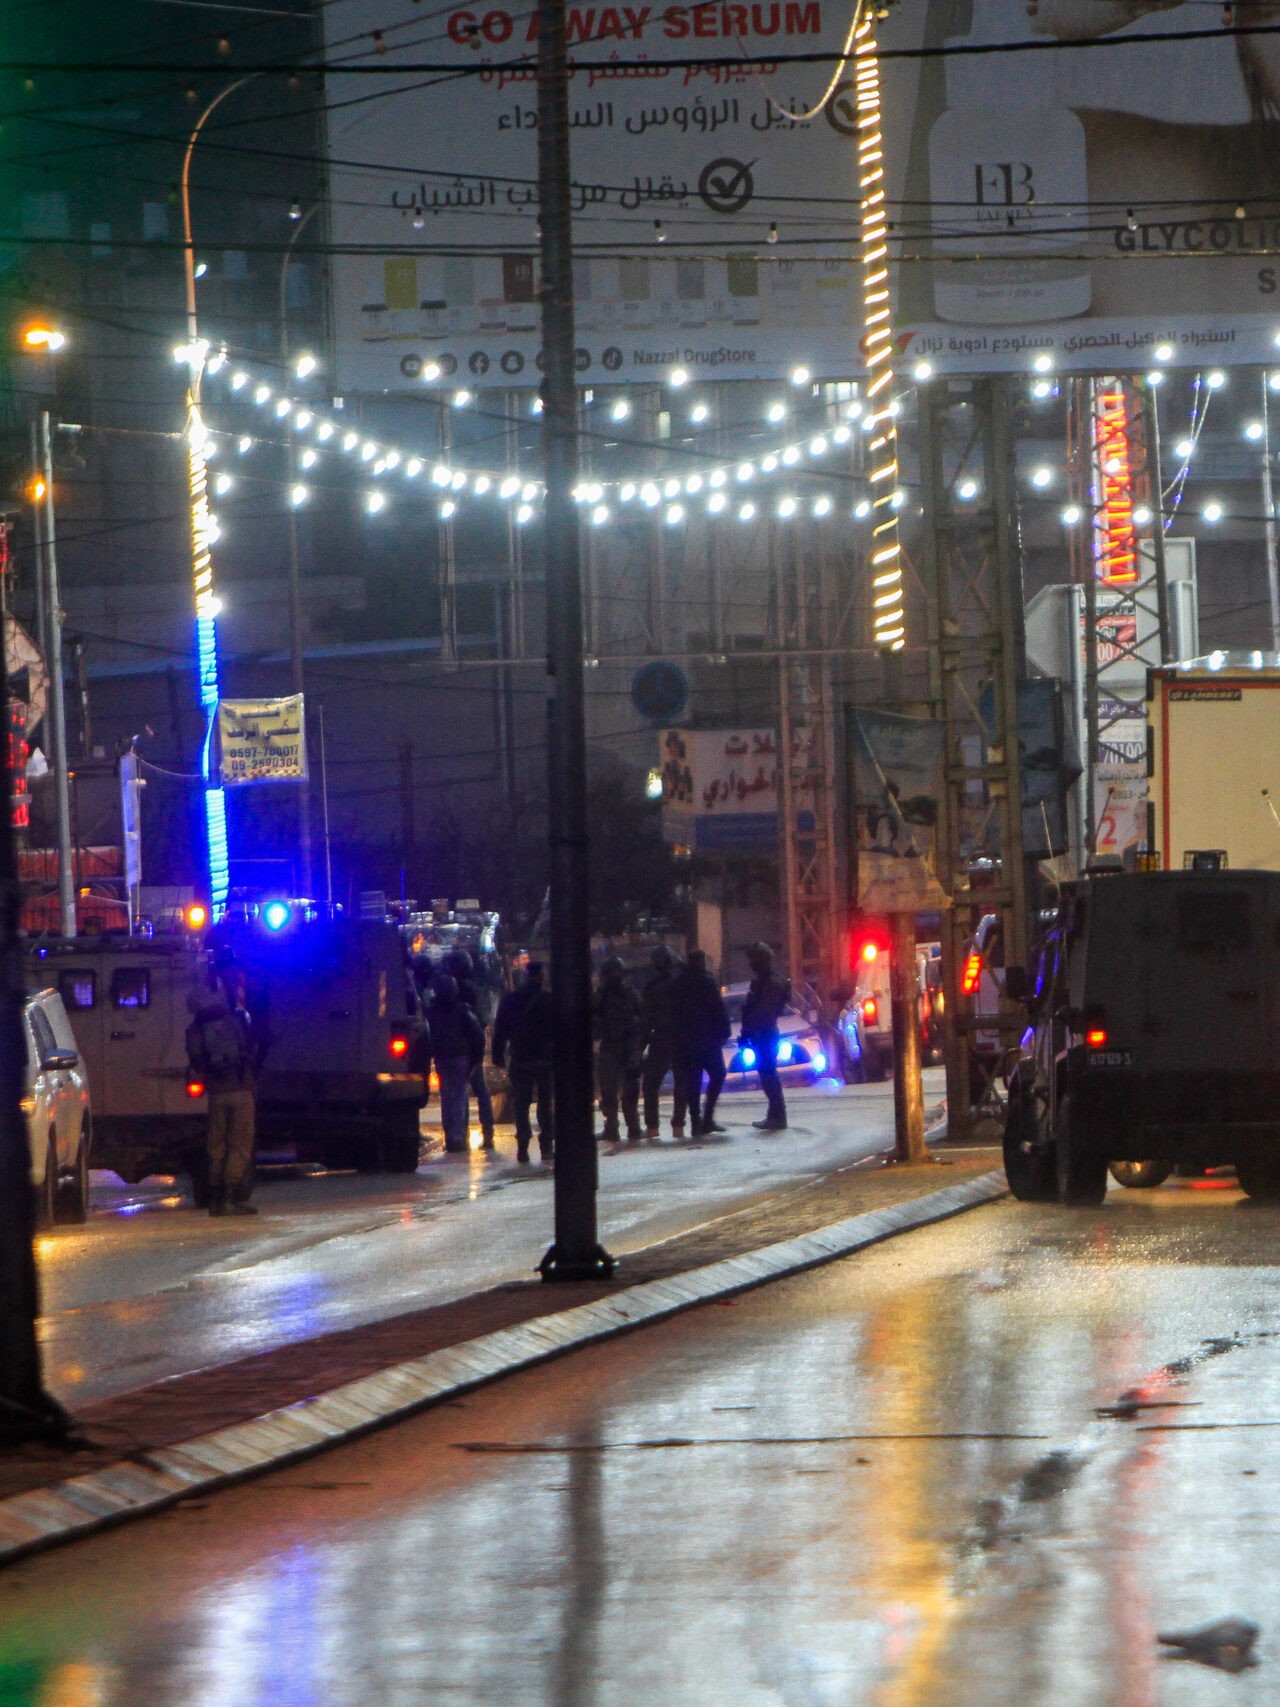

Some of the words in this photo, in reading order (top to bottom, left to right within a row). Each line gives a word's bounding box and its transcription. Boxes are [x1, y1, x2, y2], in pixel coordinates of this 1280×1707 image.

[446, 10, 513, 44] GO
[663, 2, 822, 39] SERUM
[497, 101, 614, 131] السداء
[624, 95, 740, 135] الرؤوس
[750, 97, 812, 132] يزيل
[392, 178, 496, 215] الشباب
[619, 175, 690, 210] يقلل
